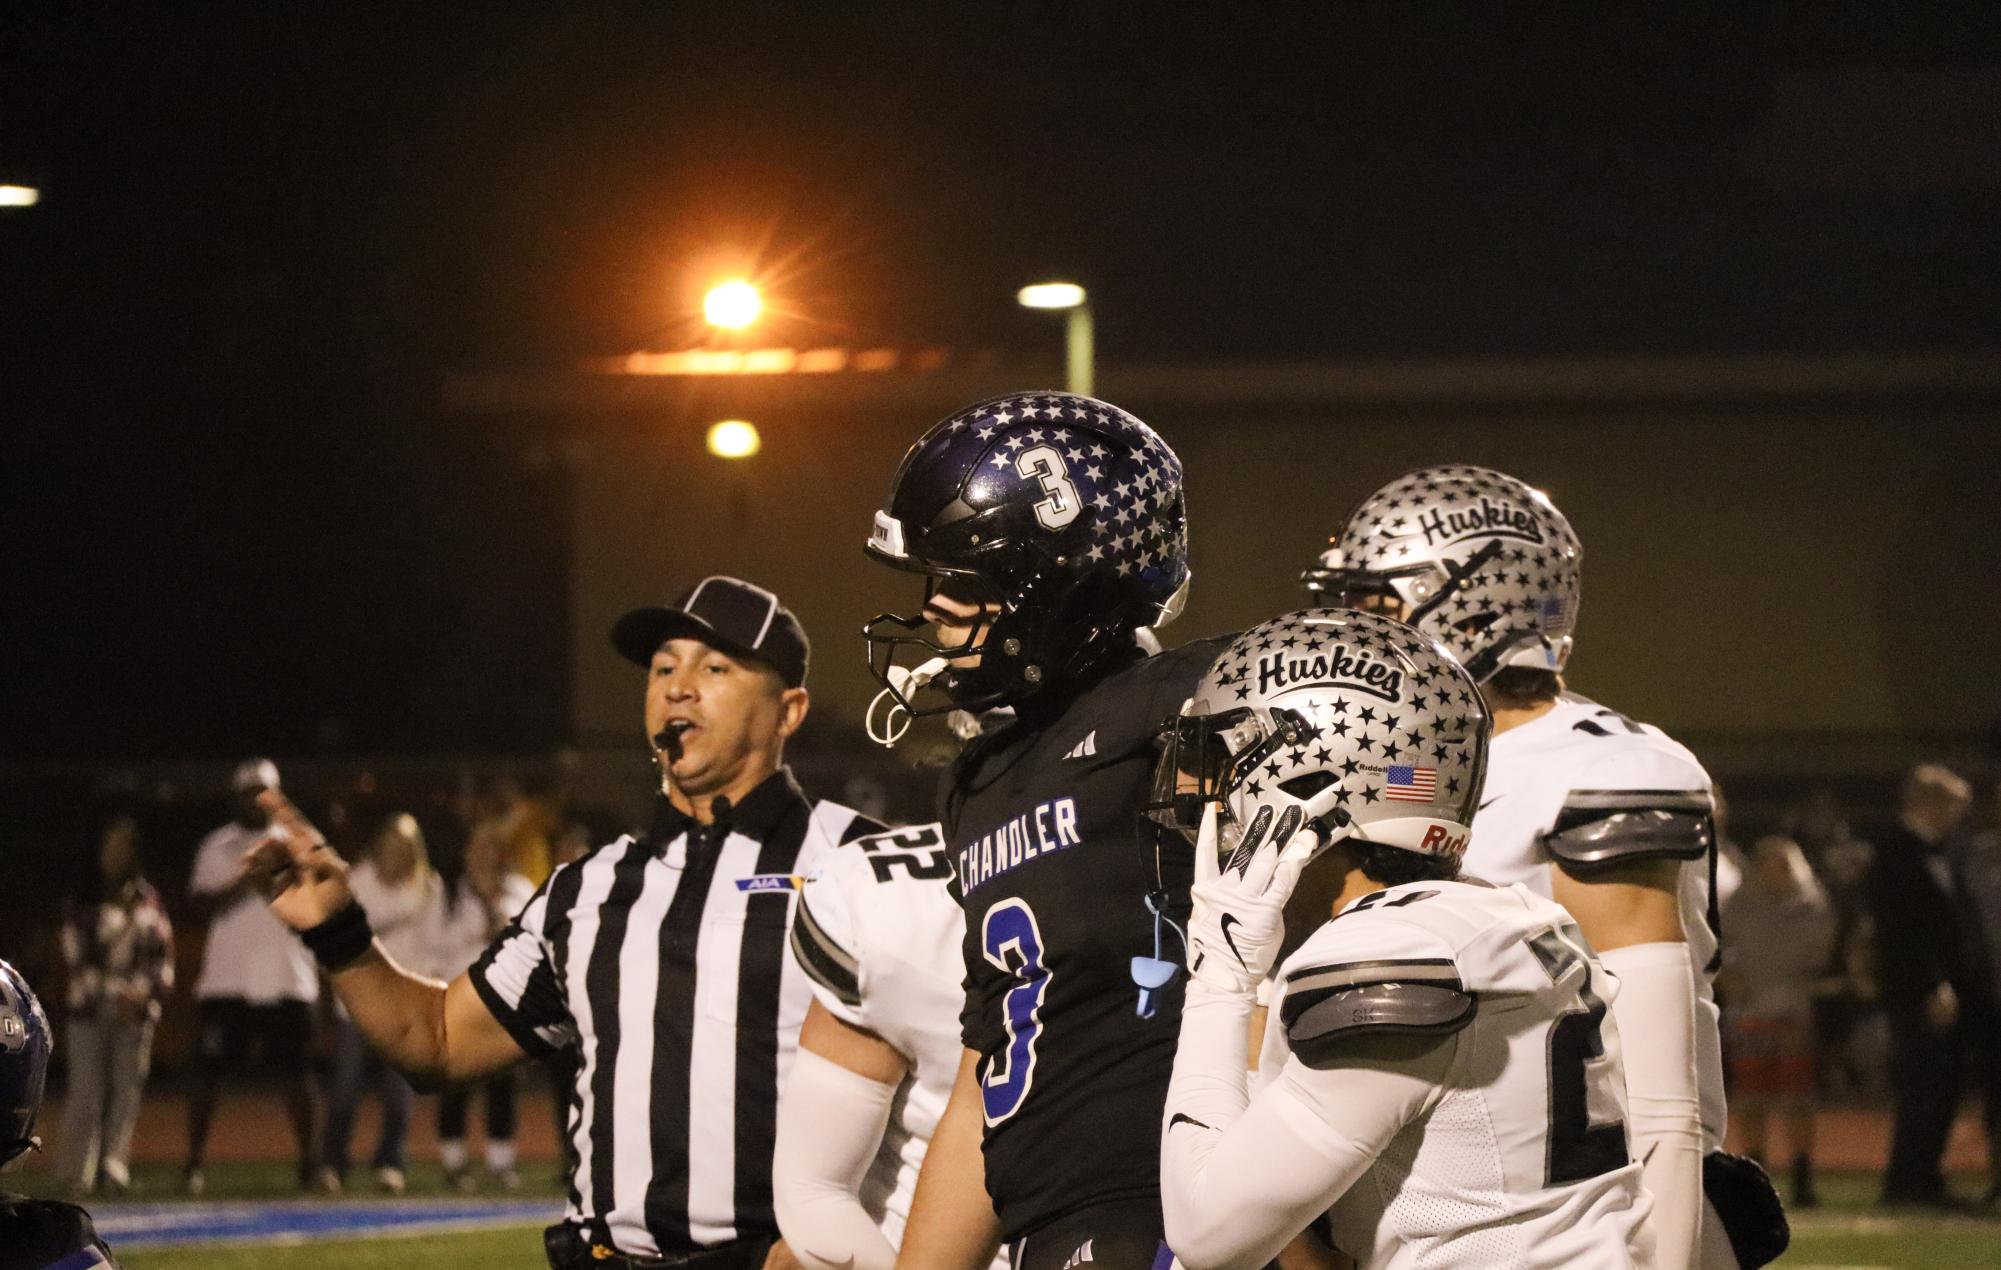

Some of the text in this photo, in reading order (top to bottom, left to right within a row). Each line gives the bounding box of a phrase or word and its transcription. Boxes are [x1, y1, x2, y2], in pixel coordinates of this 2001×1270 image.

[1015, 444, 1083, 530] 3
[1418, 498, 1544, 546] Huskies
[1258, 644, 1402, 703] Huskies
[1359, 763, 1388, 773] Riddell
[960, 797, 1082, 898] CHANDLER
[1420, 824, 1469, 855] Rid
[747, 877, 781, 889] AIA
[982, 896, 1054, 1129] 3
